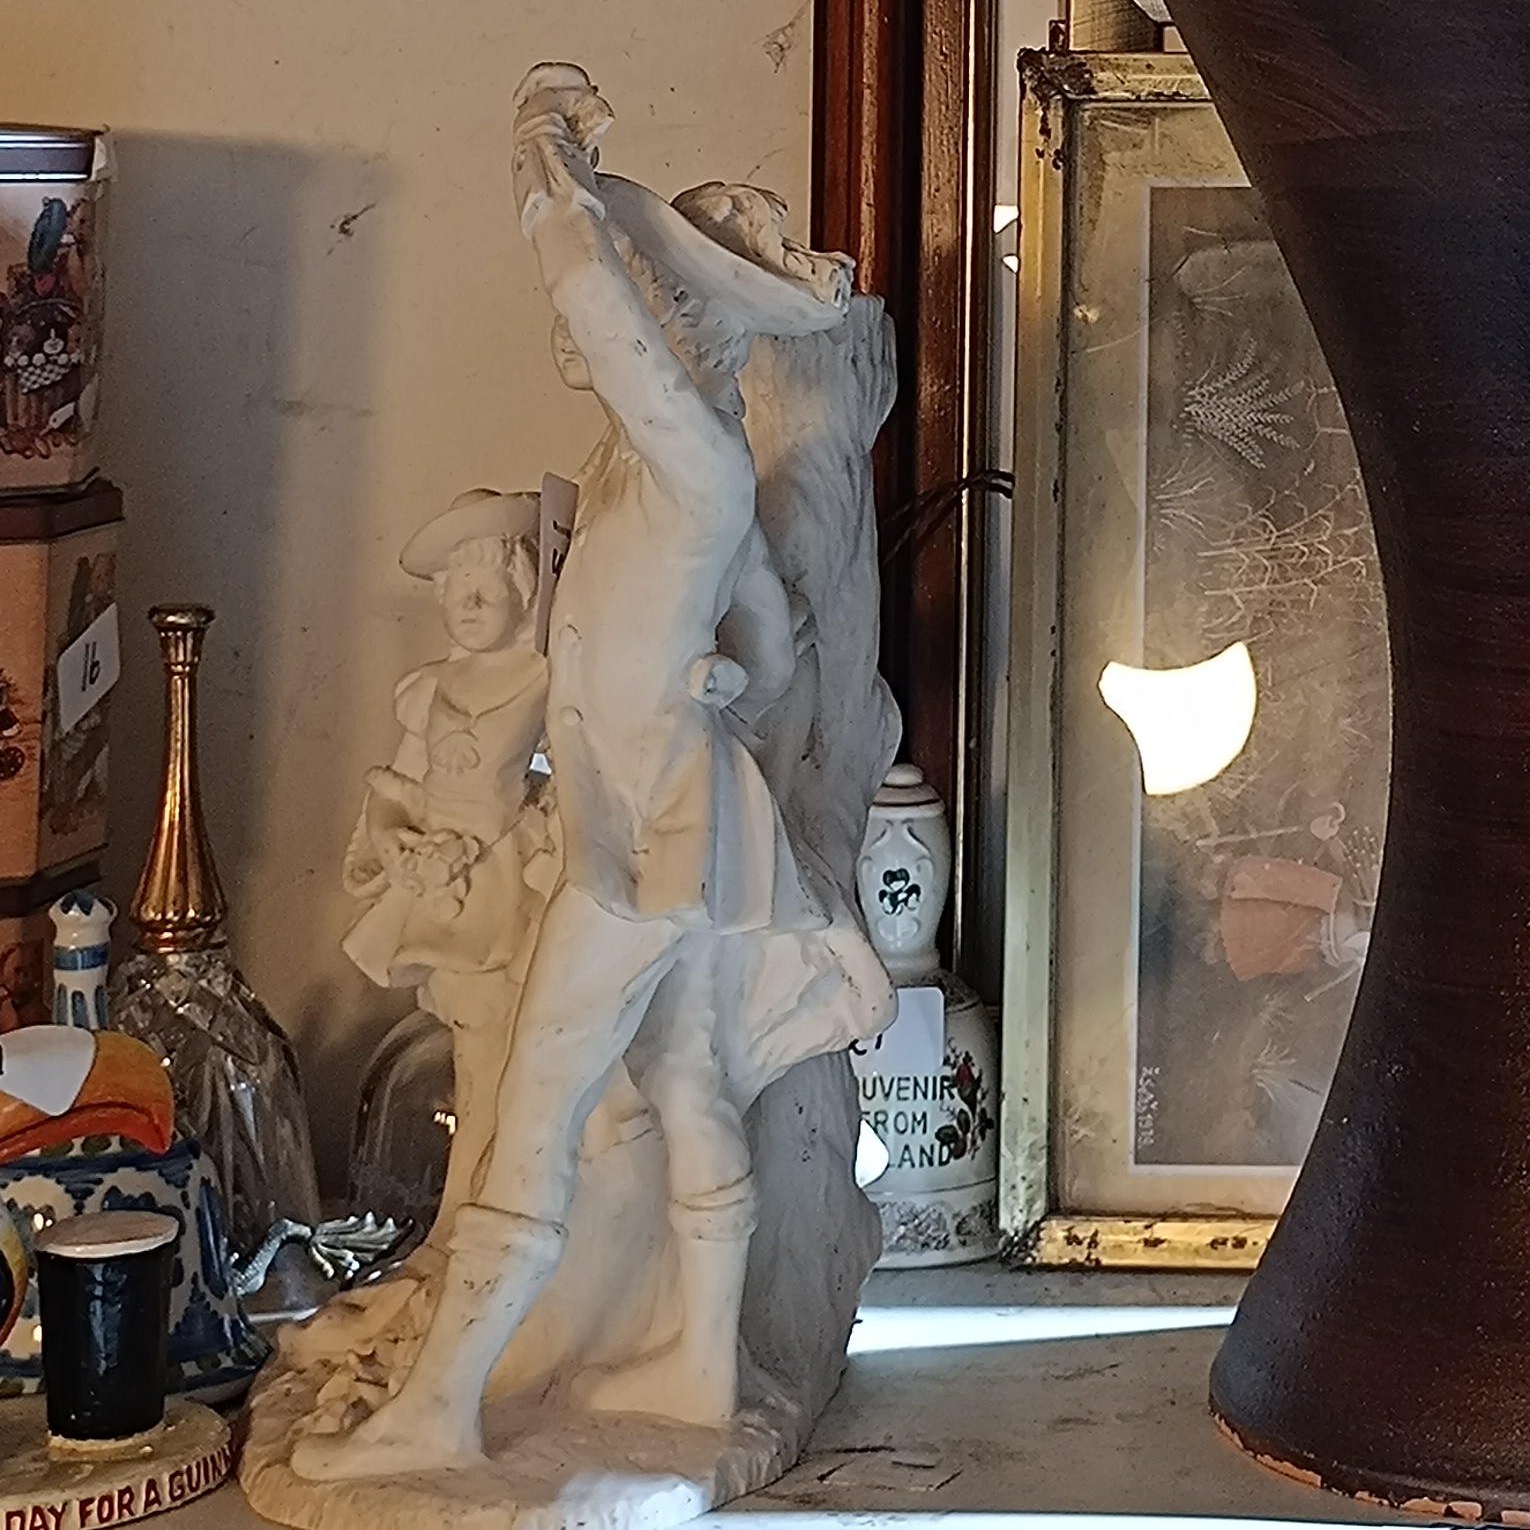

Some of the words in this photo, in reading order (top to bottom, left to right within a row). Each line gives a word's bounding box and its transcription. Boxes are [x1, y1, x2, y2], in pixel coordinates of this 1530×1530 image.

[82, 641, 101, 692] 16
[890, 1143, 952, 1168] AND
[5, 1502, 67, 1530] DAY
[78, 1485, 135, 1528] FOR
[144, 1478, 162, 1512] A
